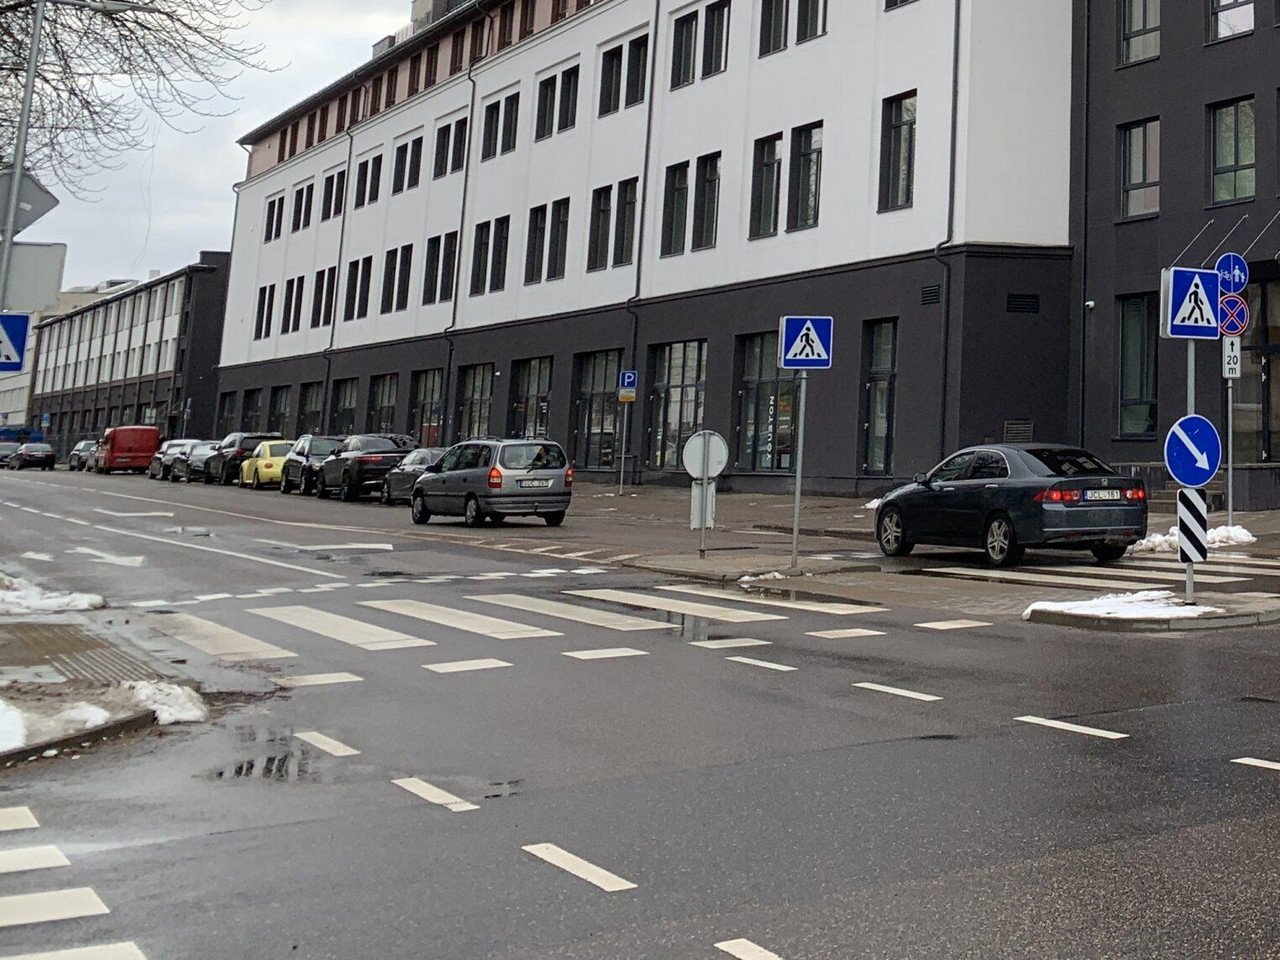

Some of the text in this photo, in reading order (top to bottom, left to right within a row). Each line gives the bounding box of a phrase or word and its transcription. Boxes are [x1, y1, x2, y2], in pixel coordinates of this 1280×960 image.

[1226, 355, 1238, 365] 20
[1228, 367, 1237, 375] m
[624, 373, 634, 386] P
